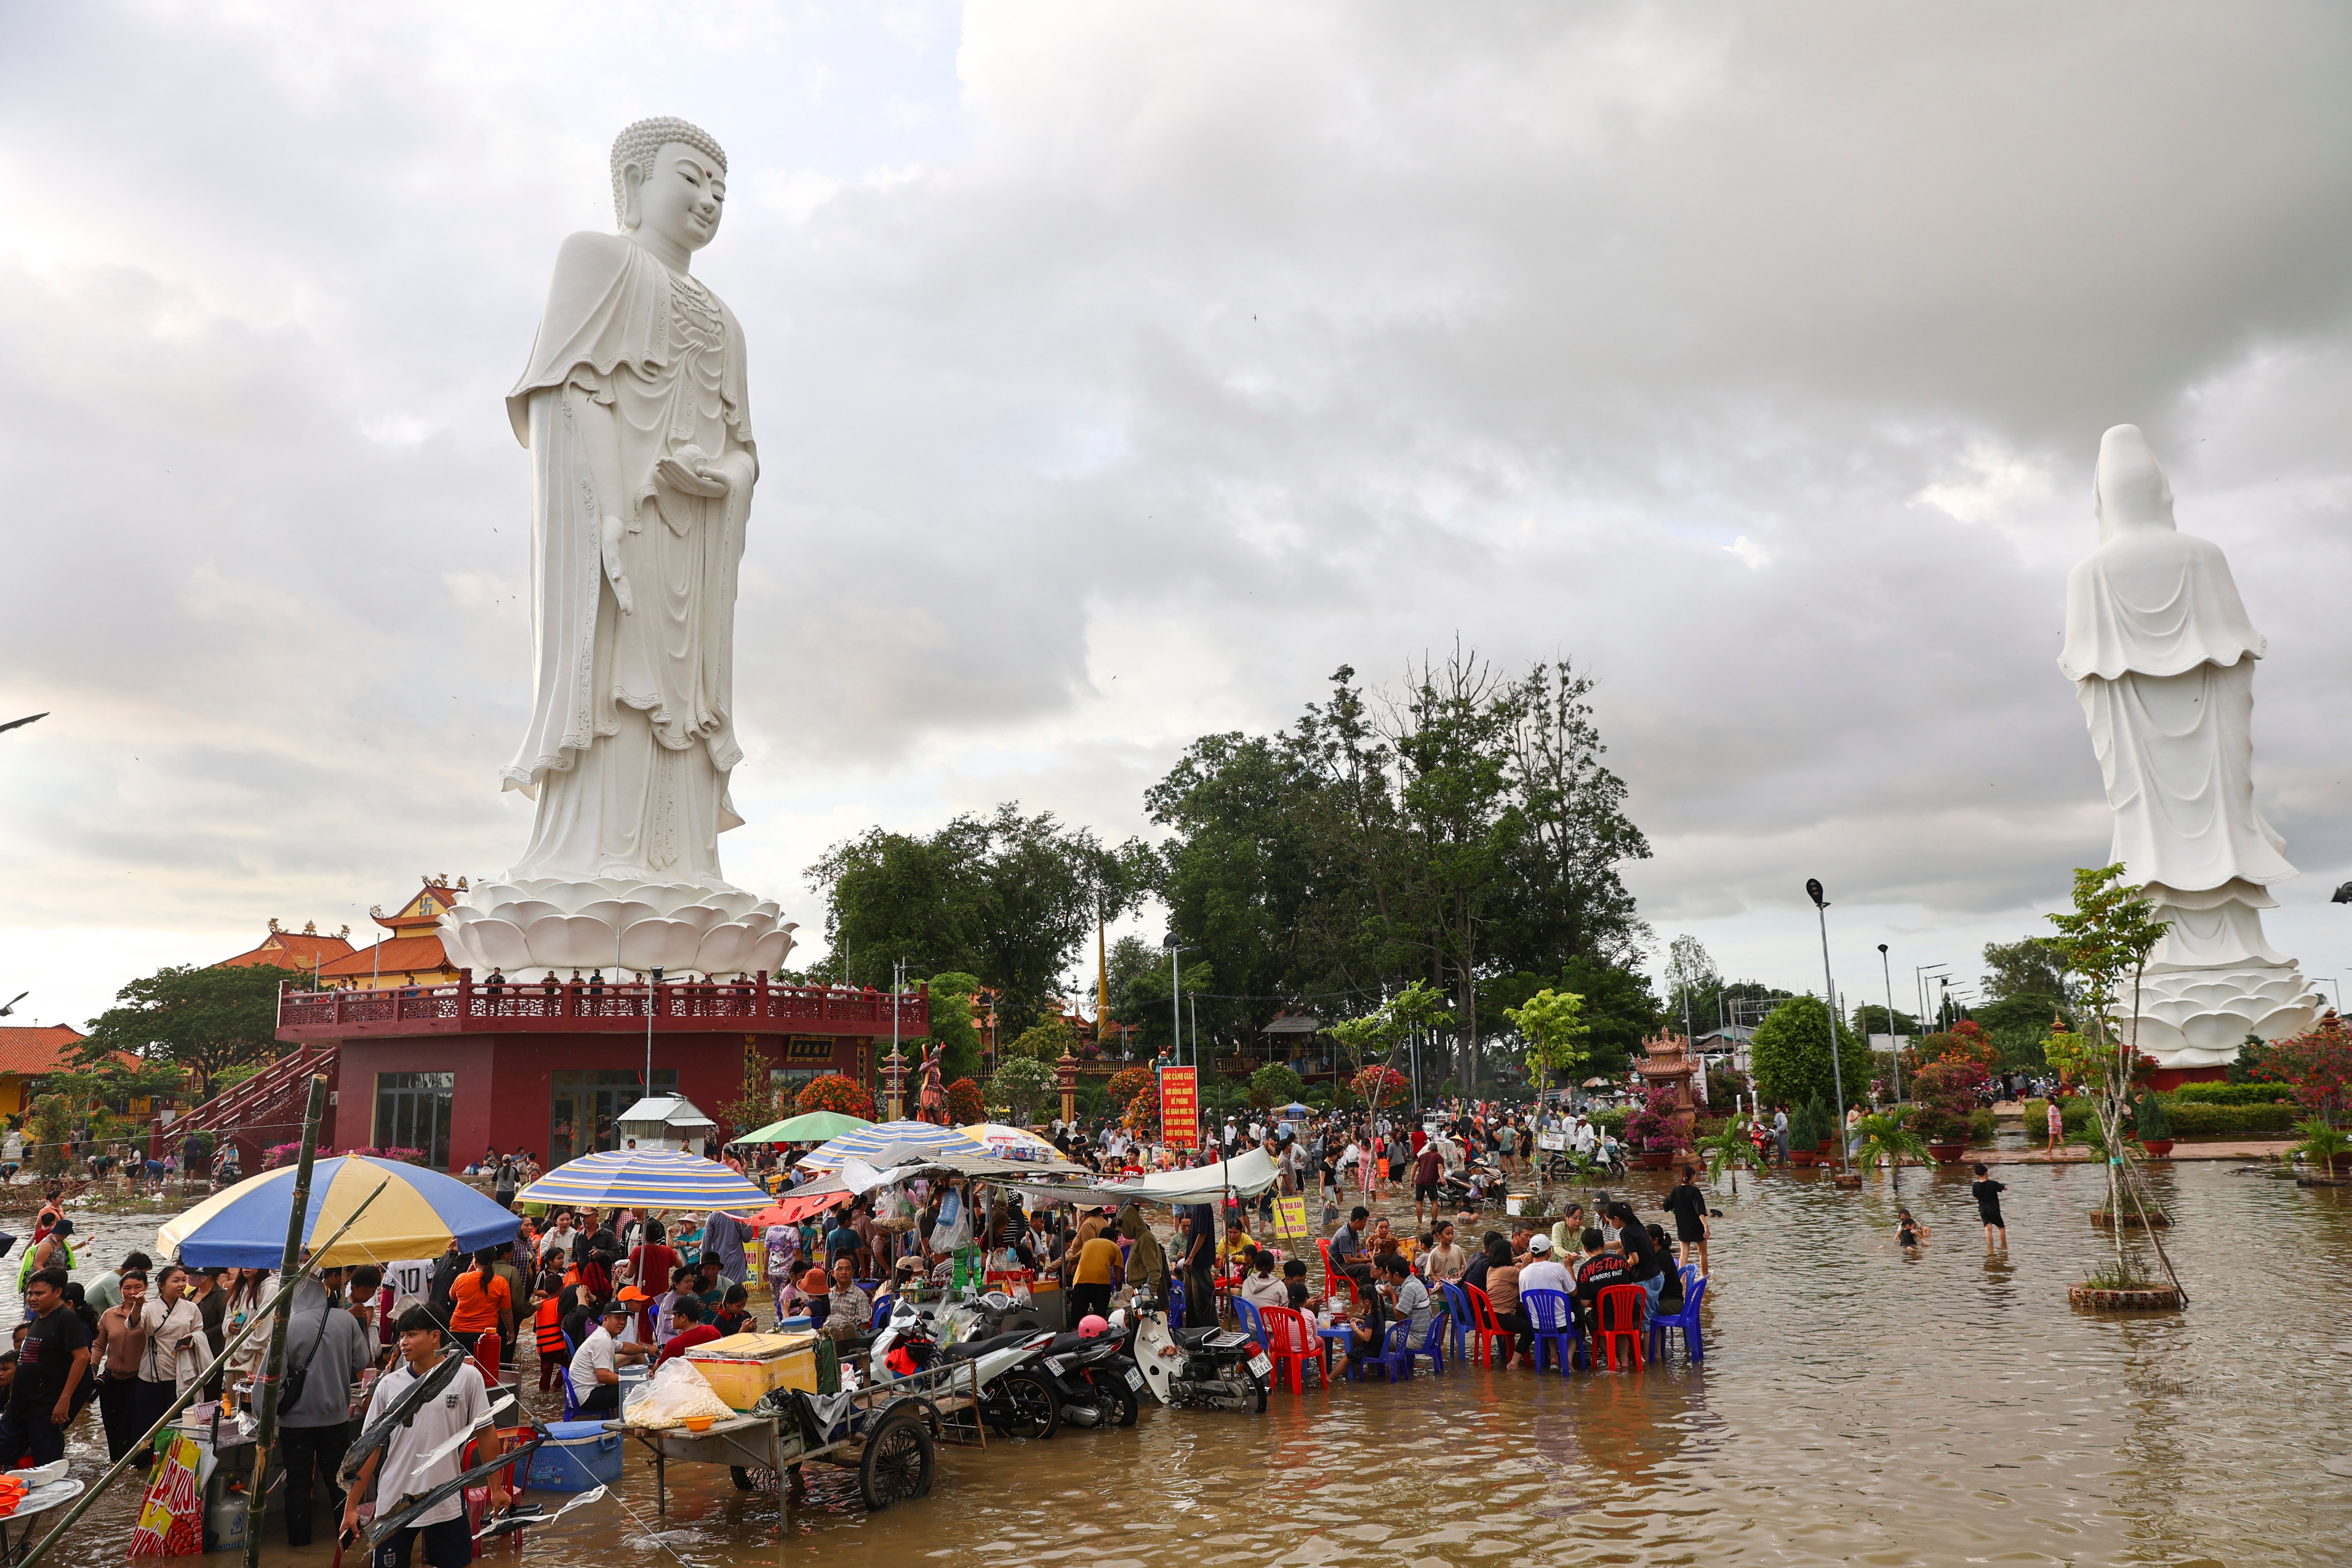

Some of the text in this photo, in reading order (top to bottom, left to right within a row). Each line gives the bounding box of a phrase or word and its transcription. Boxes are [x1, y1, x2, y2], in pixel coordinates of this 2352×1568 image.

[1163, 1070, 1194, 1080] GÓC CẢNH GIÁC
[1182, 1087, 1193, 1095] NGƯỜI
[1176, 1096, 1188, 1105] PHÒNG
[1180, 1107, 1188, 1115] MÓC
[1174, 1128, 1183, 1138] ĐIỆN
[1294, 1200, 1302, 1209] BÁN
[1285, 1214, 1296, 1222] TRONG
[1297, 1223, 1306, 1232] CHÙA
[747, 1270, 757, 1286] Cây
[1589, 1268, 1623, 1283] MEMBERS ONLY
[398, 1268, 420, 1295] 10
[1251, 1354, 1265, 1368] 67-AH
[1253, 1361, 1271, 1376] 039.46
[1130, 1375, 1143, 1390] 389.16
[534, 1457, 553, 1465] MATSU
